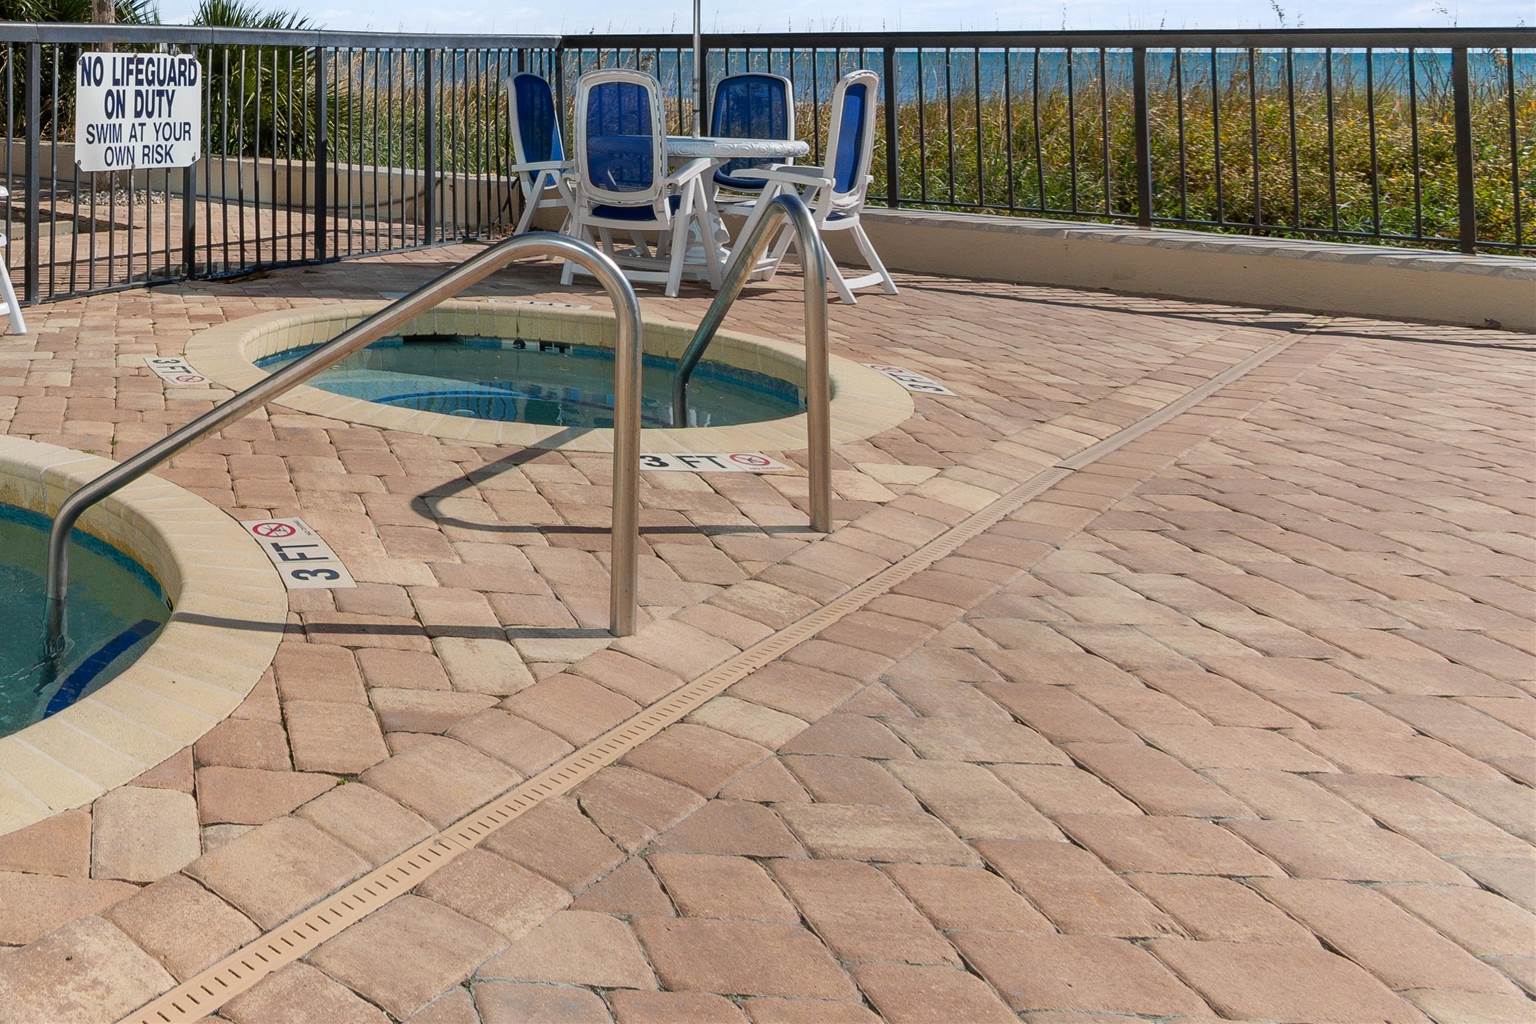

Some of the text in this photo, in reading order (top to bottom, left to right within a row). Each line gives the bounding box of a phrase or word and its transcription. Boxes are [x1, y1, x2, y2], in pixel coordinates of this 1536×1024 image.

[80, 56, 198, 87] NO LIFEGUARD
[104, 89, 176, 120] ON DUTY
[86, 121, 192, 145] SWIM AT YOUR
[104, 144, 175, 167] OWN RISK
[640, 455, 727, 469] 3 FT
[270, 541, 340, 582] 3 FT
